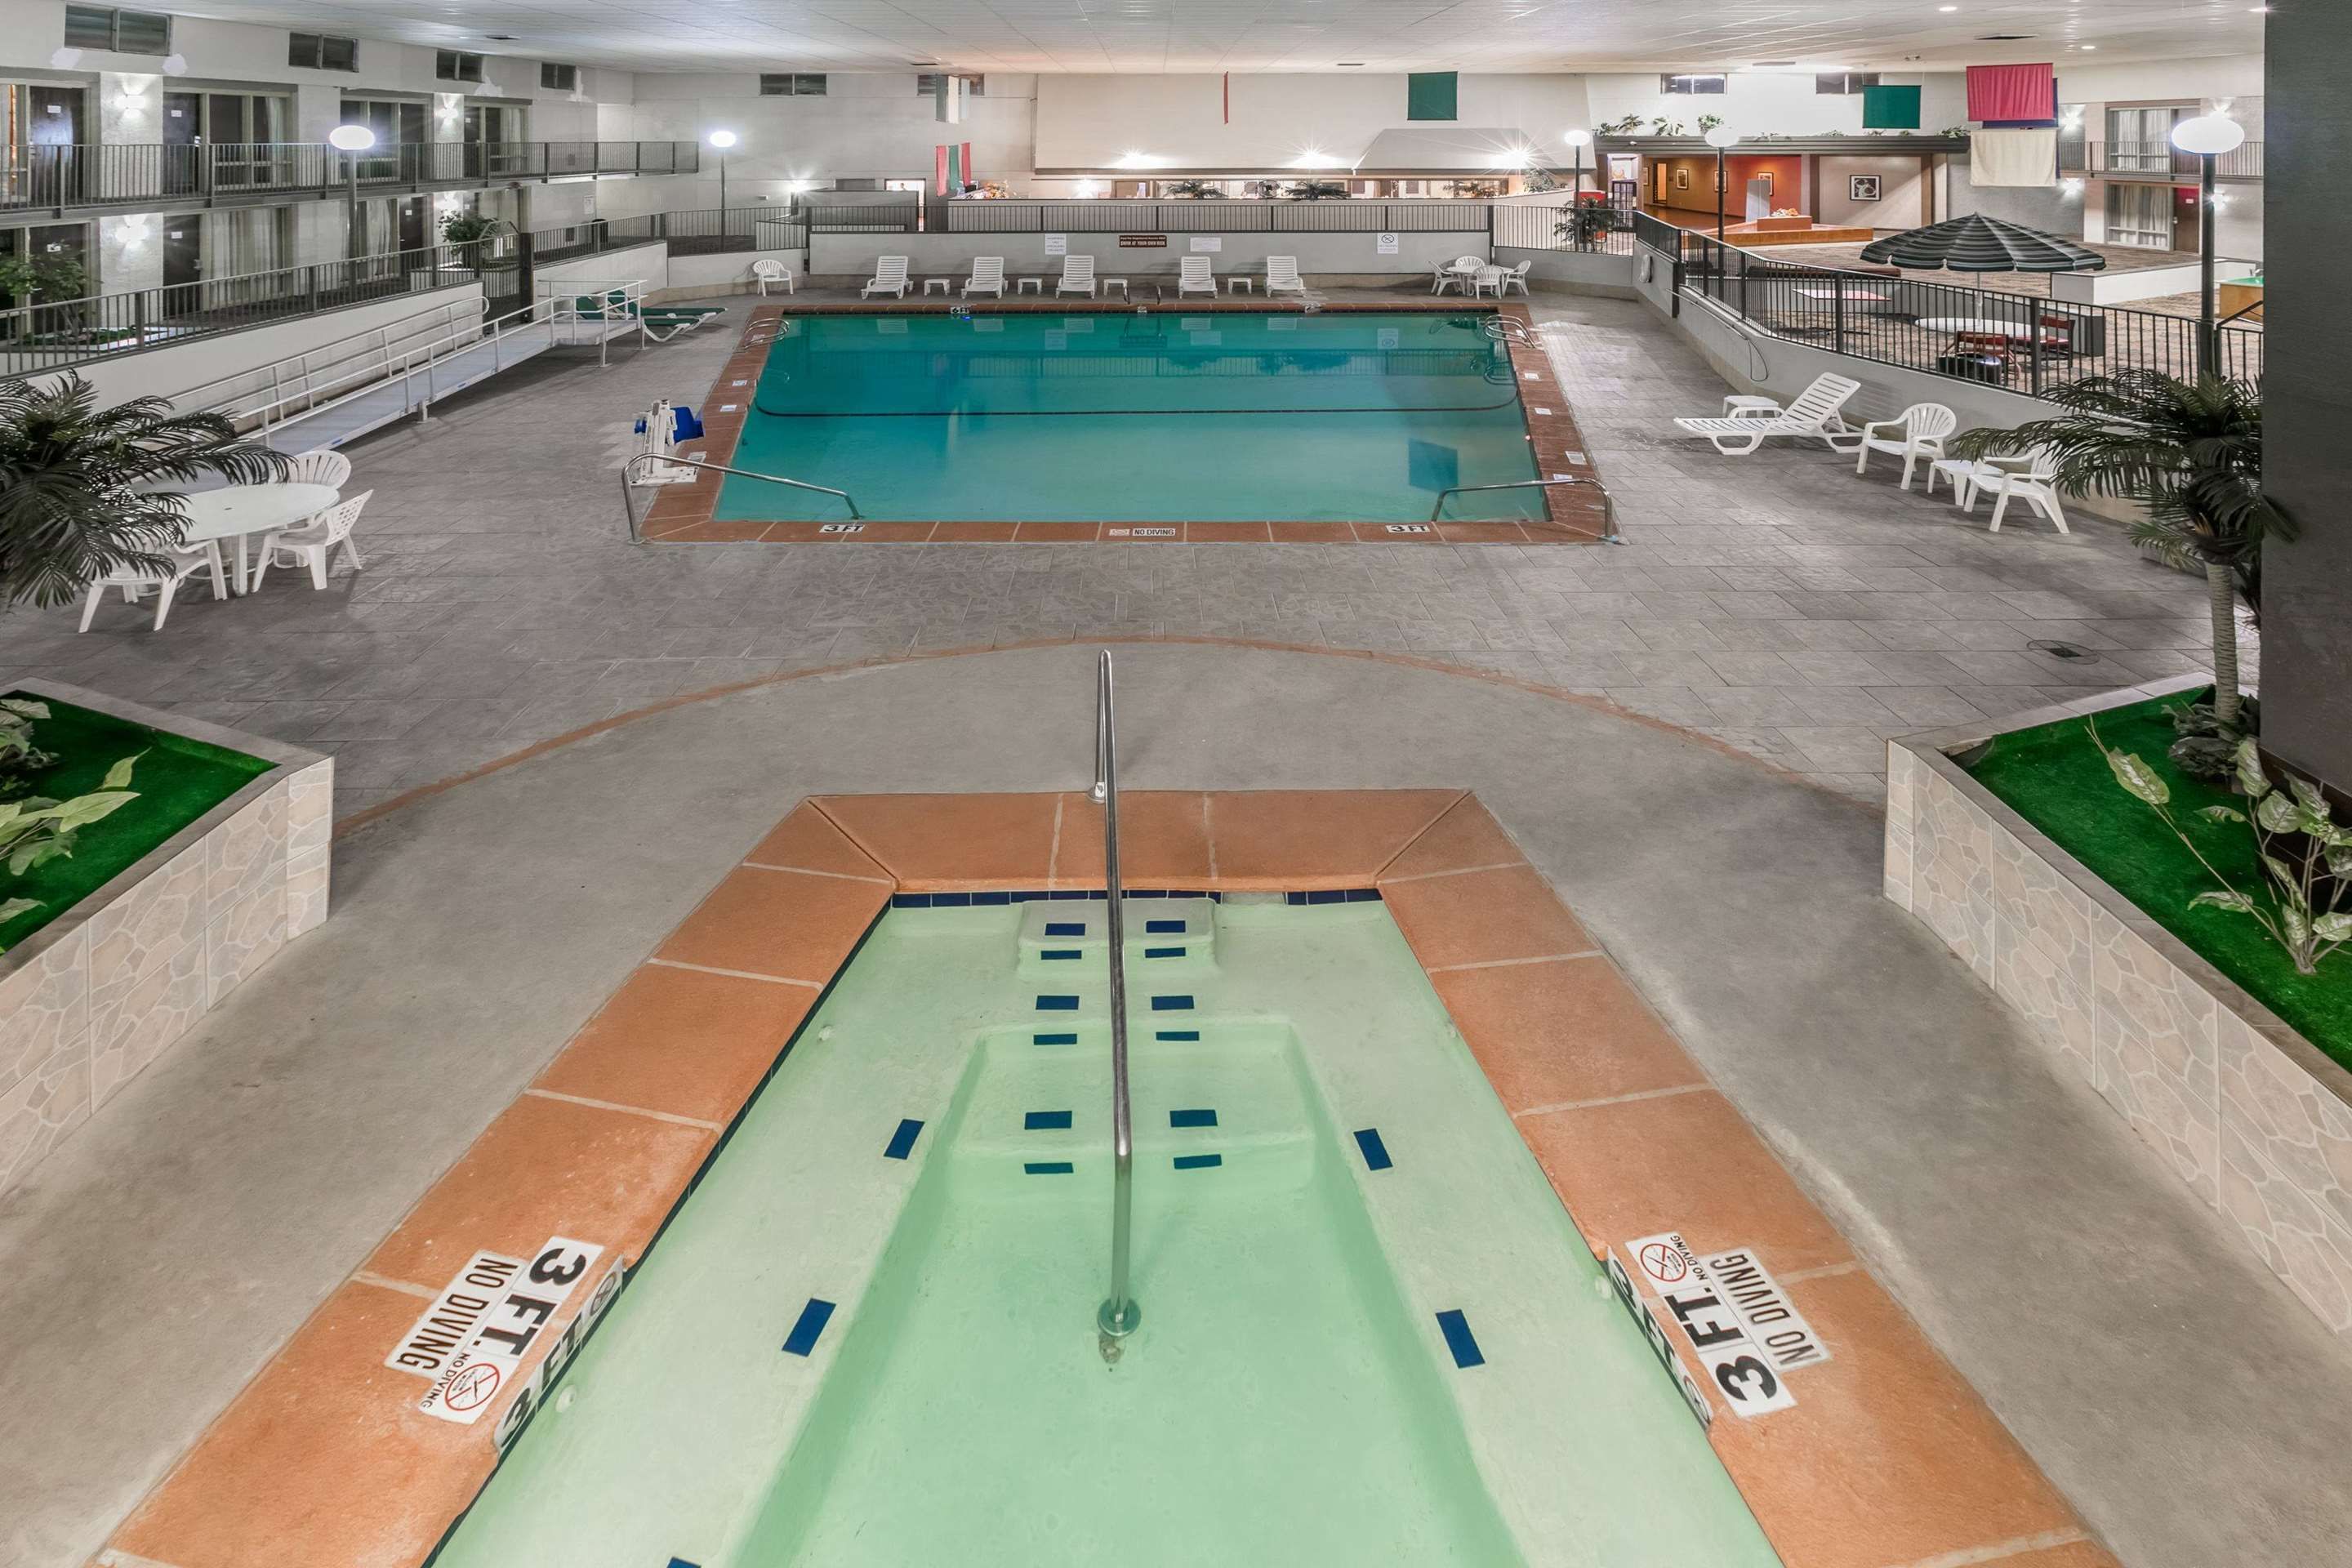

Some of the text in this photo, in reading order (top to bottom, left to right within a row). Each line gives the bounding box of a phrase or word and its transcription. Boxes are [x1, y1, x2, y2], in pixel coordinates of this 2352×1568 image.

[1670, 1235, 1698, 1266] DIVING
[1693, 1267, 1708, 1281] NO
[396, 1258, 519, 1370] NO DIVING
[473, 1247, 587, 1356] 3 FT.
[1709, 1254, 1820, 1366] NO DIVING
[452, 1352, 471, 1368] NO
[1664, 1286, 1778, 1401] 3 FT.
[420, 1369, 457, 1409] DIVING
